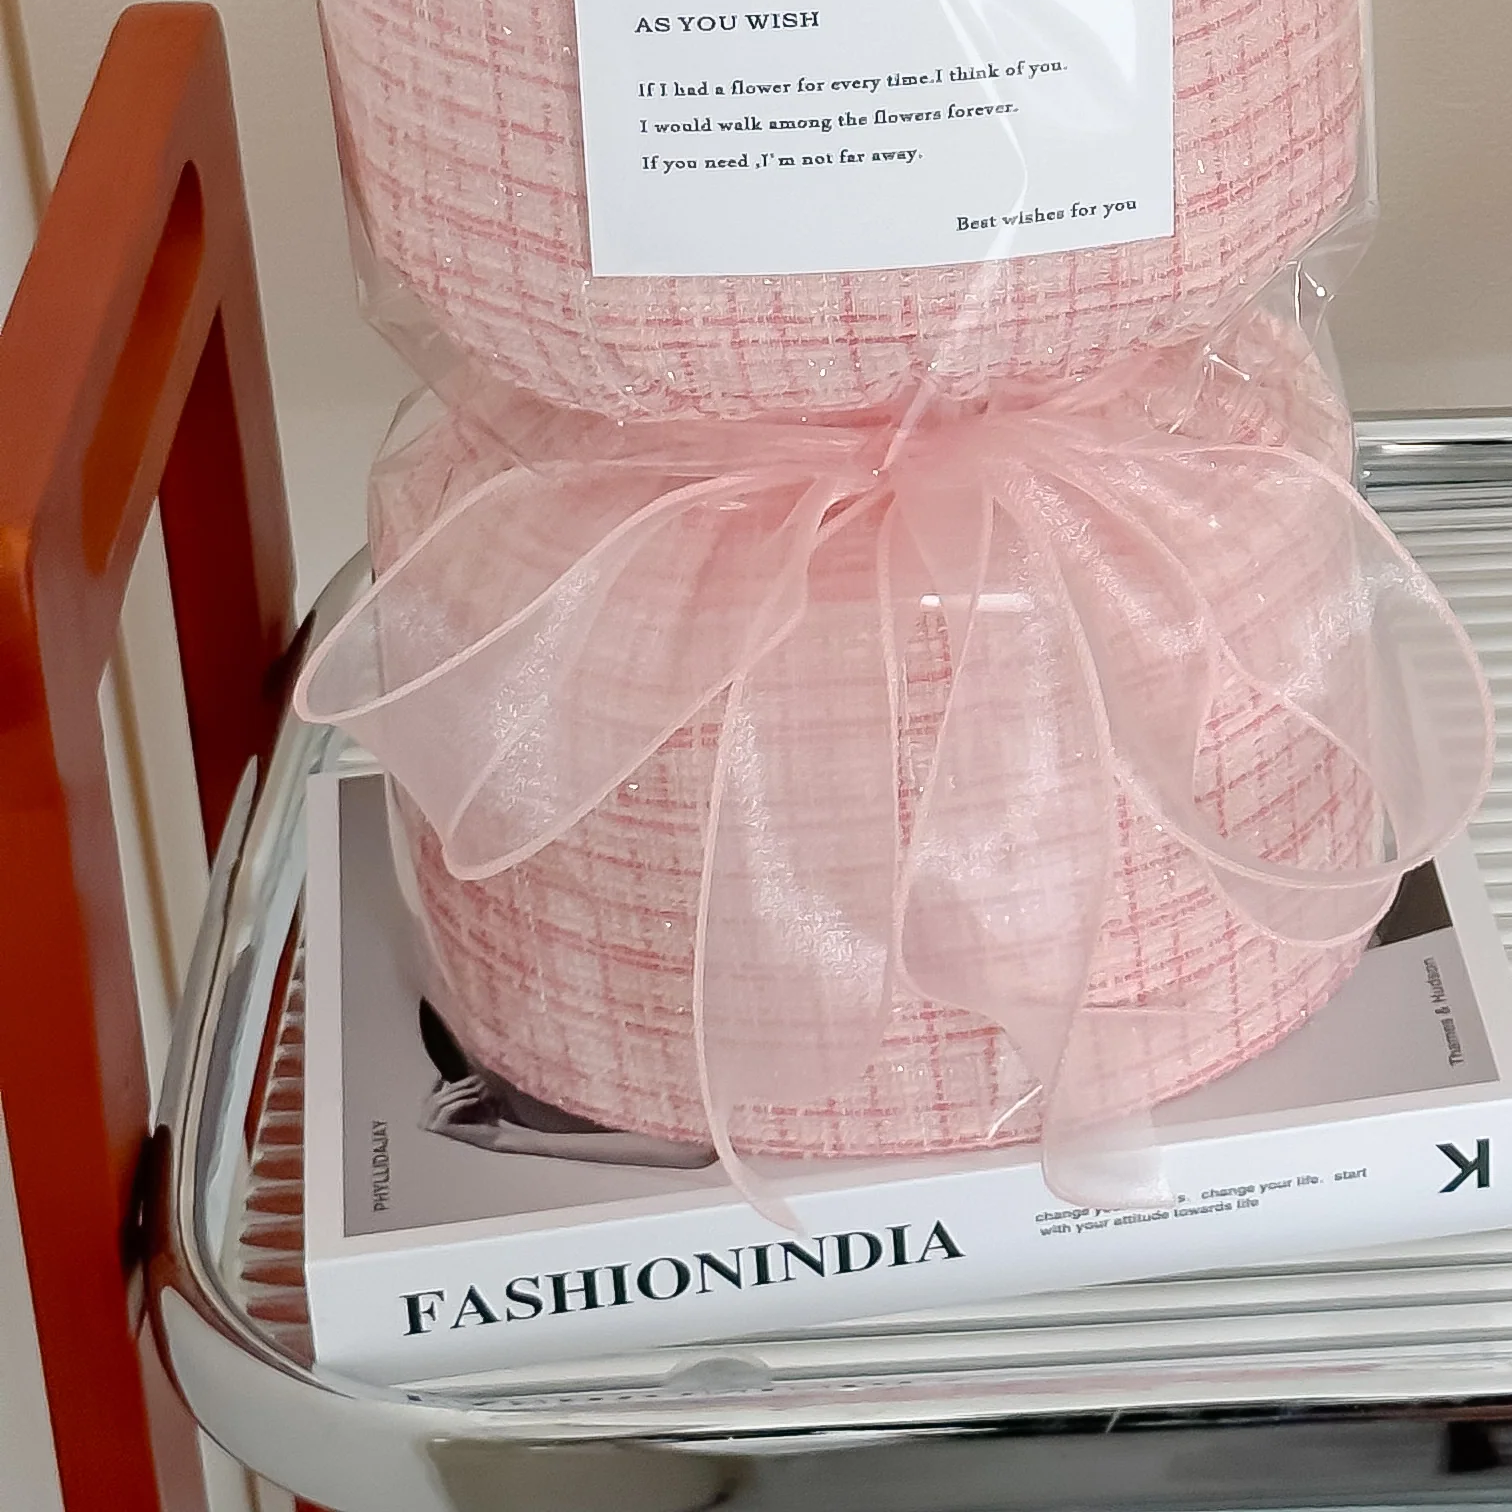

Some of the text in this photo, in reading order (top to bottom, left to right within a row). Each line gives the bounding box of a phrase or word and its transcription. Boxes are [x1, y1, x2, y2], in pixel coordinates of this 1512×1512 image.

[634, 11, 819, 34] AS YOU WISH
[639, 83, 655, 97] If
[660, 83, 667, 96] I
[674, 81, 709, 96] had
[715, 87, 725, 95] a
[731, 80, 791, 95] flower
[798, 78, 825, 92] for
[830, 76, 881, 93] every
[949, 64, 999, 82] think
[1006, 61, 1025, 76] of
[1028, 61, 1068, 79] you.
[640, 102, 1019, 133] I would walk among the flowers forever.
[642, 156, 659, 169] If
[663, 159, 697, 174] you
[705, 154, 749, 168] need
[802, 154, 833, 165] not
[839, 149, 865, 164] far
[871, 148, 923, 164] away.
[957, 200, 1137, 231] Best wishes for you
[1035, 1208, 1090, 1222] change
[1201, 1184, 1256, 1199] change
[1260, 1179, 1292, 1194] your
[1334, 1168, 1367, 1181] start
[1040, 1225, 1071, 1236] with
[1076, 1219, 1109, 1234] your
[1114, 1211, 1170, 1226] attitude
[1174, 1201, 1232, 1217] towards
[1237, 1198, 1259, 1208] life
[403, 1219, 966, 1337] FASHIONINDIA
